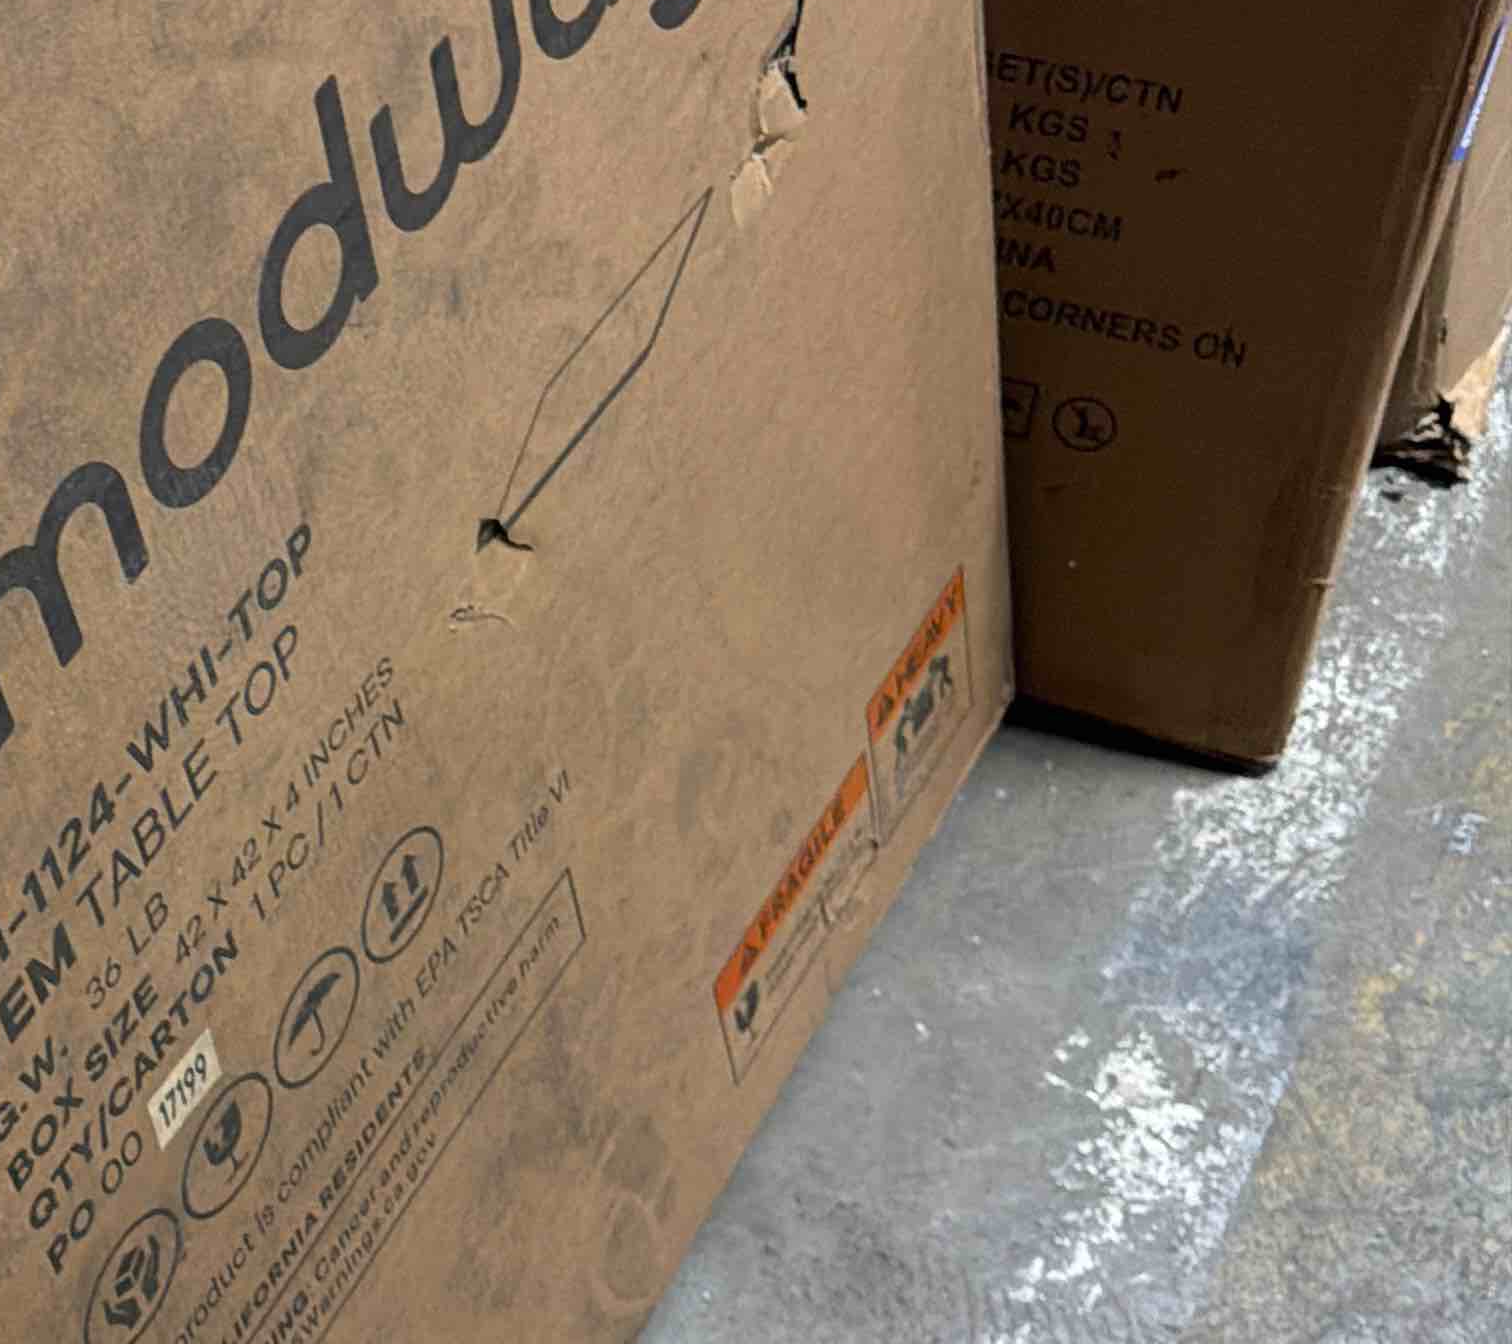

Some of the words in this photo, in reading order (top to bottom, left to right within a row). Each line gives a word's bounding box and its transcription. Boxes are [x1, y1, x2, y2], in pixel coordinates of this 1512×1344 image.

[999, 147, 1082, 190] KGS
[1008, 102, 1089, 144] KGS
[994, 191, 1123, 241] X40CM
[998, 236, 1057, 274] INA
[1002, 289, 1183, 353] CORNERS
[1192, 330, 1248, 369] ON
[74, 737, 220, 930] TABLE
[214, 623, 300, 747] TOP
[6, 1076, 86, 1193] BOX
[84, 972, 161, 1083] SIZE
[173, 913, 209, 967] 42
[205, 891, 230, 922] X
[230, 836, 262, 892] 42
[259, 804, 284, 840] X
[283, 782, 302, 816] 4
[300, 655, 396, 788] INCHES
[29, 928, 240, 1231] QTY/CARTON
[249, 888, 270, 924] 1
[266, 830, 314, 903] PC
[343, 696, 407, 789] CTN
[86, 954, 123, 1010] 36
[125, 891, 171, 958] LB
[276, 1058, 375, 1204] compliant
[372, 996, 417, 1061] with
[414, 935, 458, 999] EPA
[456, 861, 511, 939] TSCA
[45, 1197, 96, 1276] PO
[158, 1052, 209, 1129] 17199
[378, 1132, 414, 1190] and
